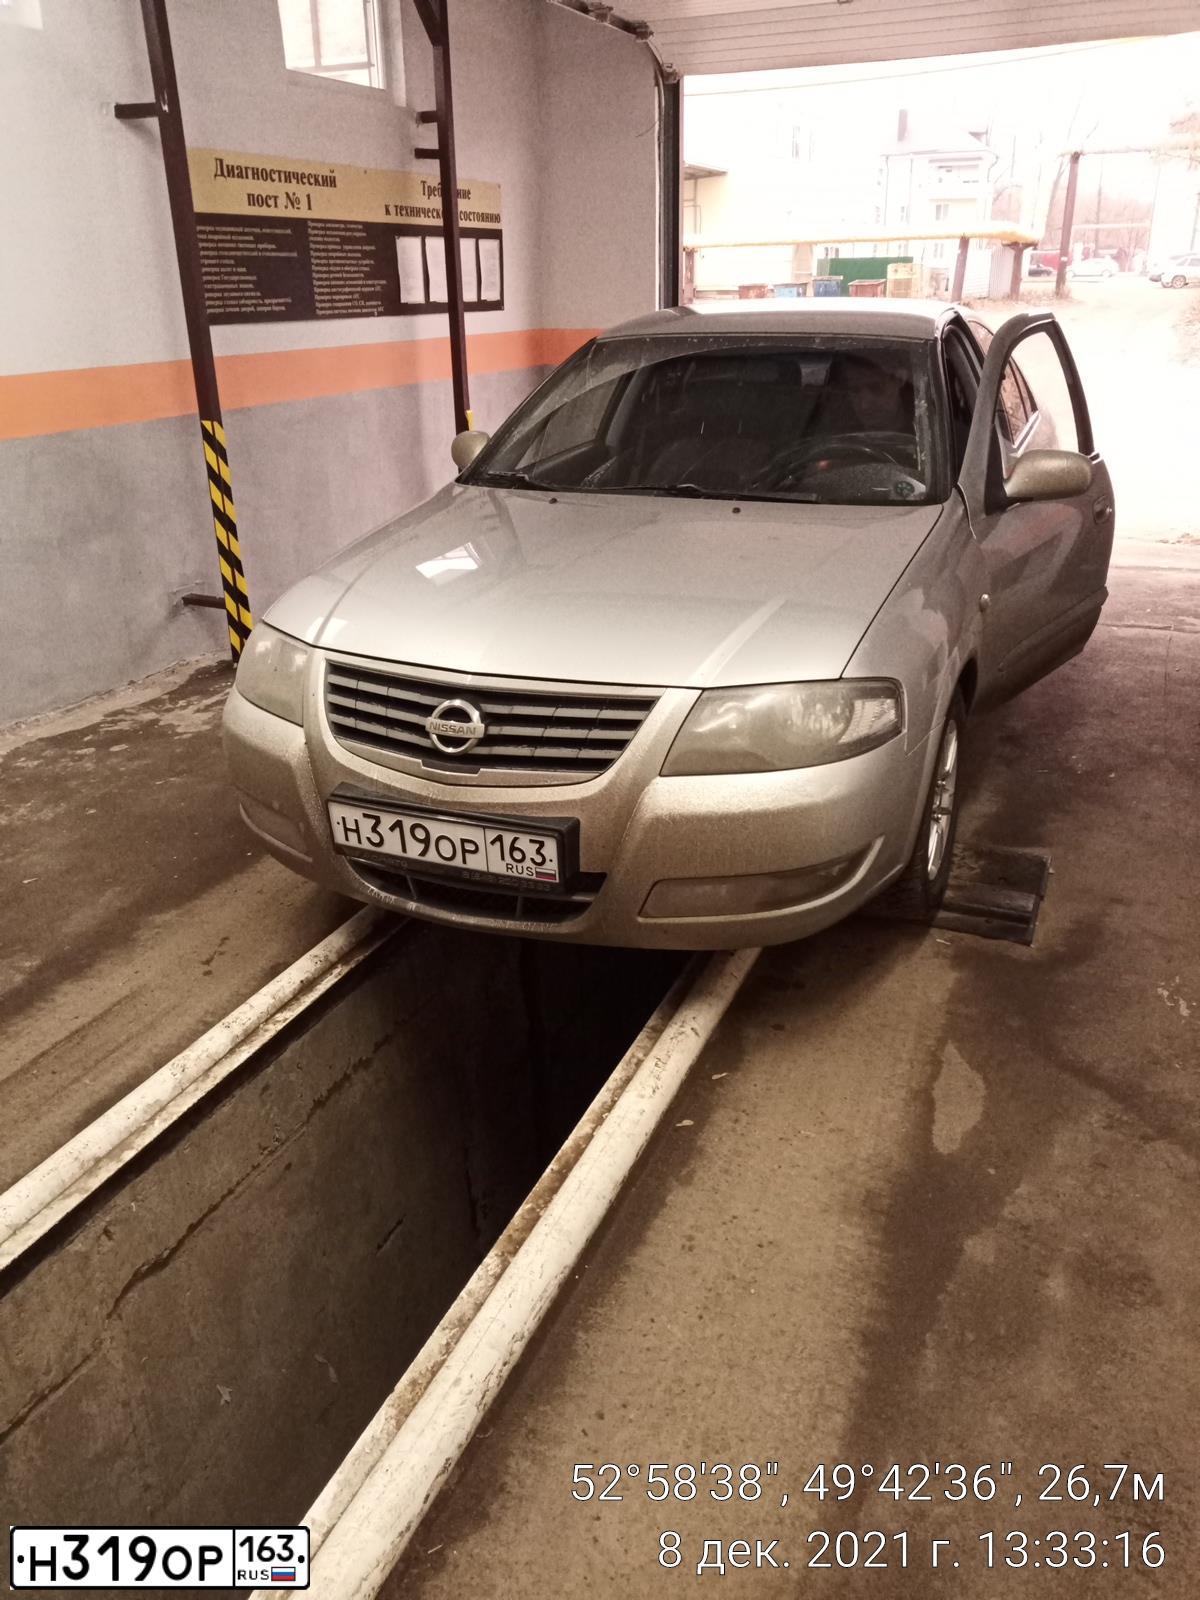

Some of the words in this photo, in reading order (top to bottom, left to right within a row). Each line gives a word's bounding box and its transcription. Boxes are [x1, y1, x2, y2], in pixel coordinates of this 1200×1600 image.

[214, 157, 336, 188] Диагностический
[247, 193, 279, 209] пост
[284, 191, 300, 210] №
[305, 193, 312, 211] 1
[459, 210, 501, 224] состоянию
[429, 721, 477, 736] NISSAN
[341, 812, 480, 865] Н319ОР
[489, 834, 547, 867] 163
[505, 862, 535, 877] RUS
